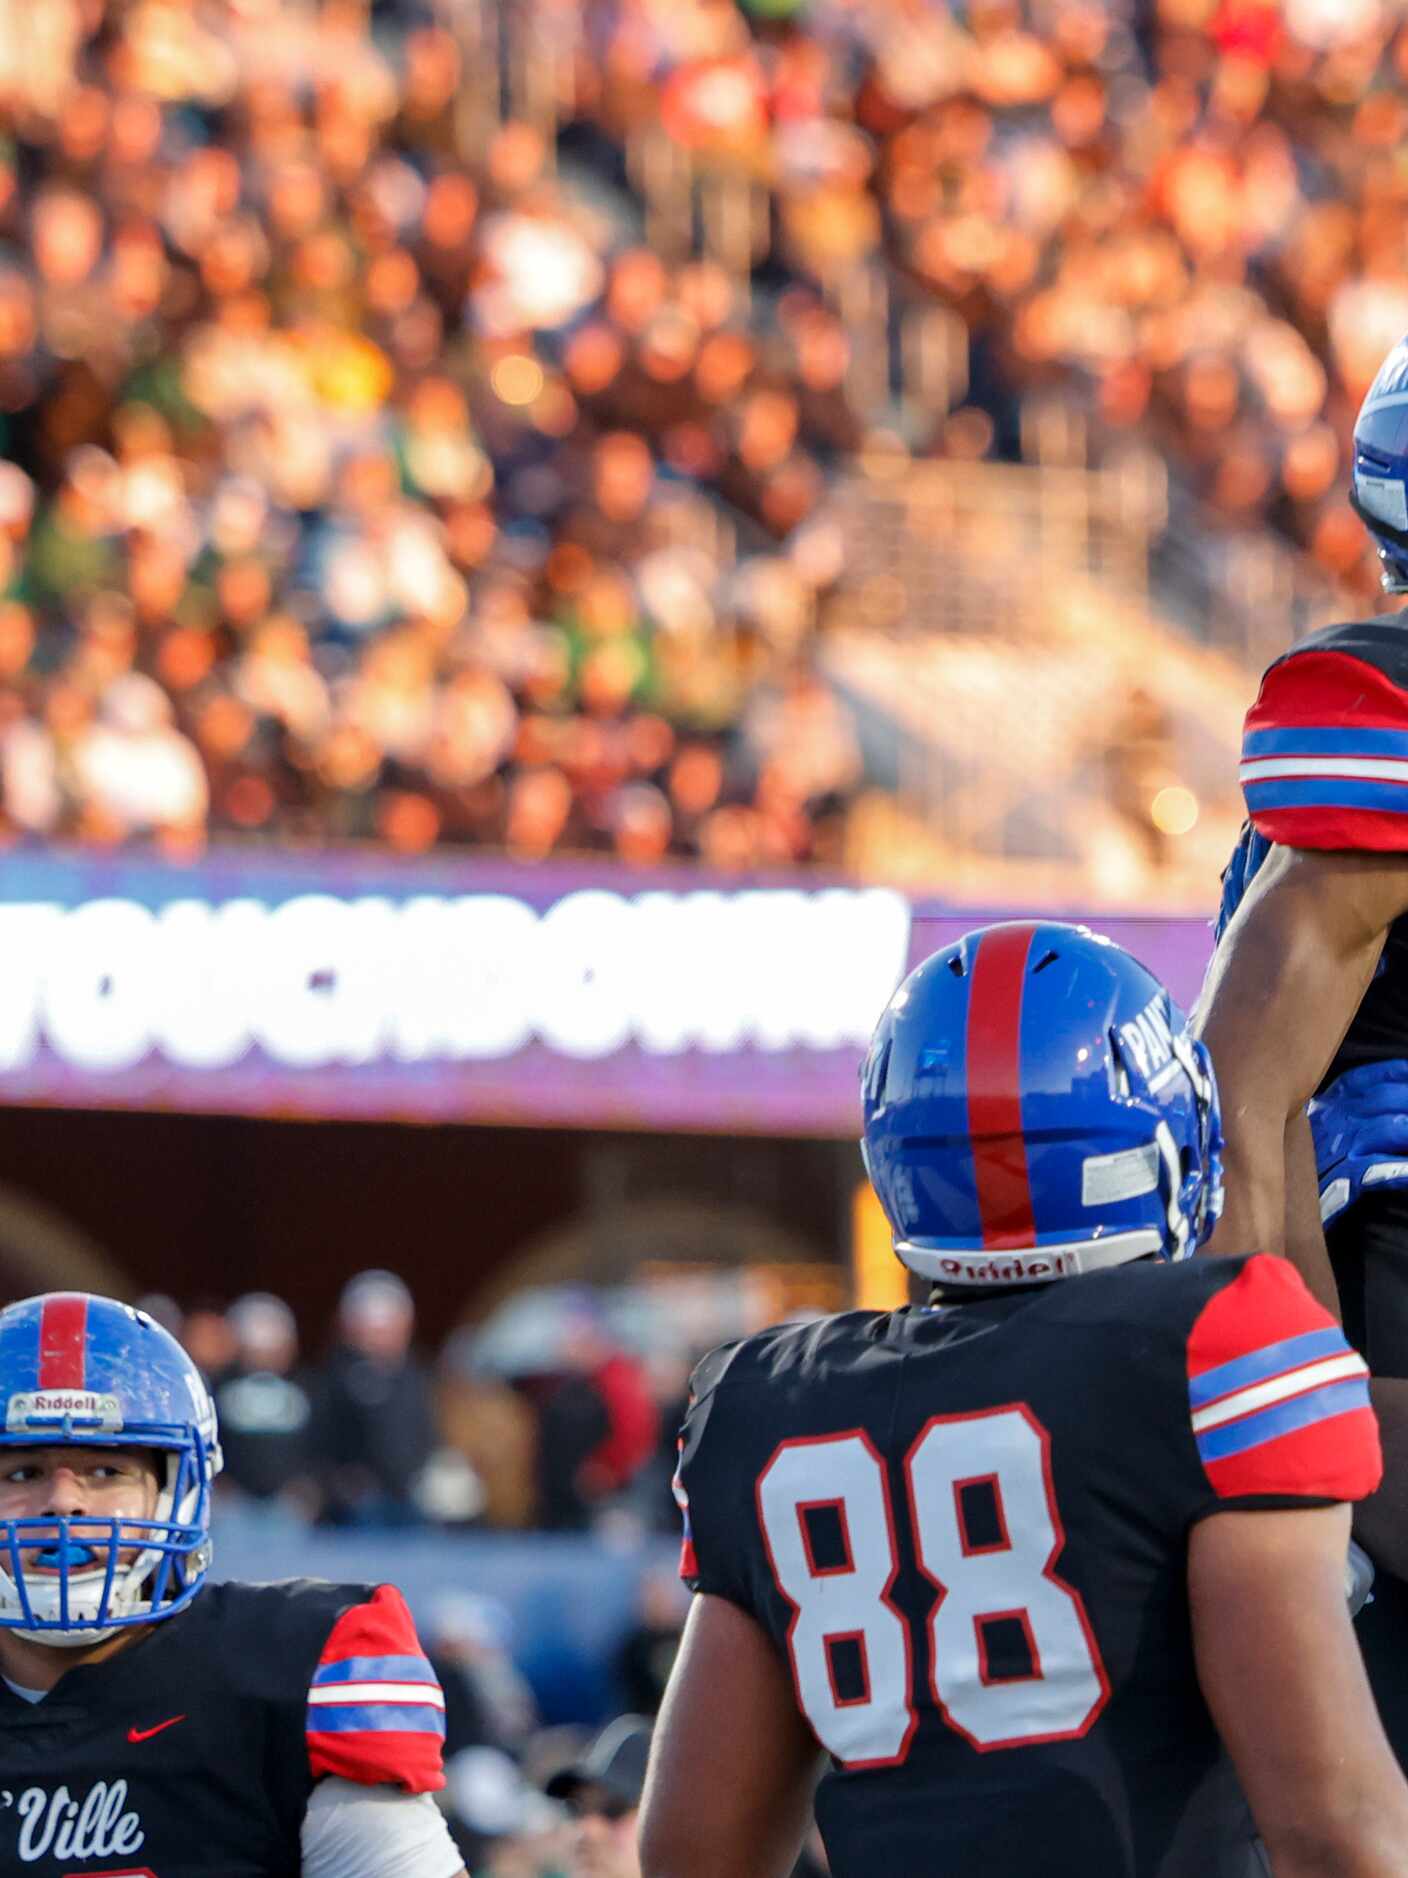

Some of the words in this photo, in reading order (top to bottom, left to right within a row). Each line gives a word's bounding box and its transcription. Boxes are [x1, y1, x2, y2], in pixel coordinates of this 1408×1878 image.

[34, 1396, 96, 1410] Riddell
[755, 1402, 1112, 1771] 88
[0, 1778, 146, 1862] 'Ville
